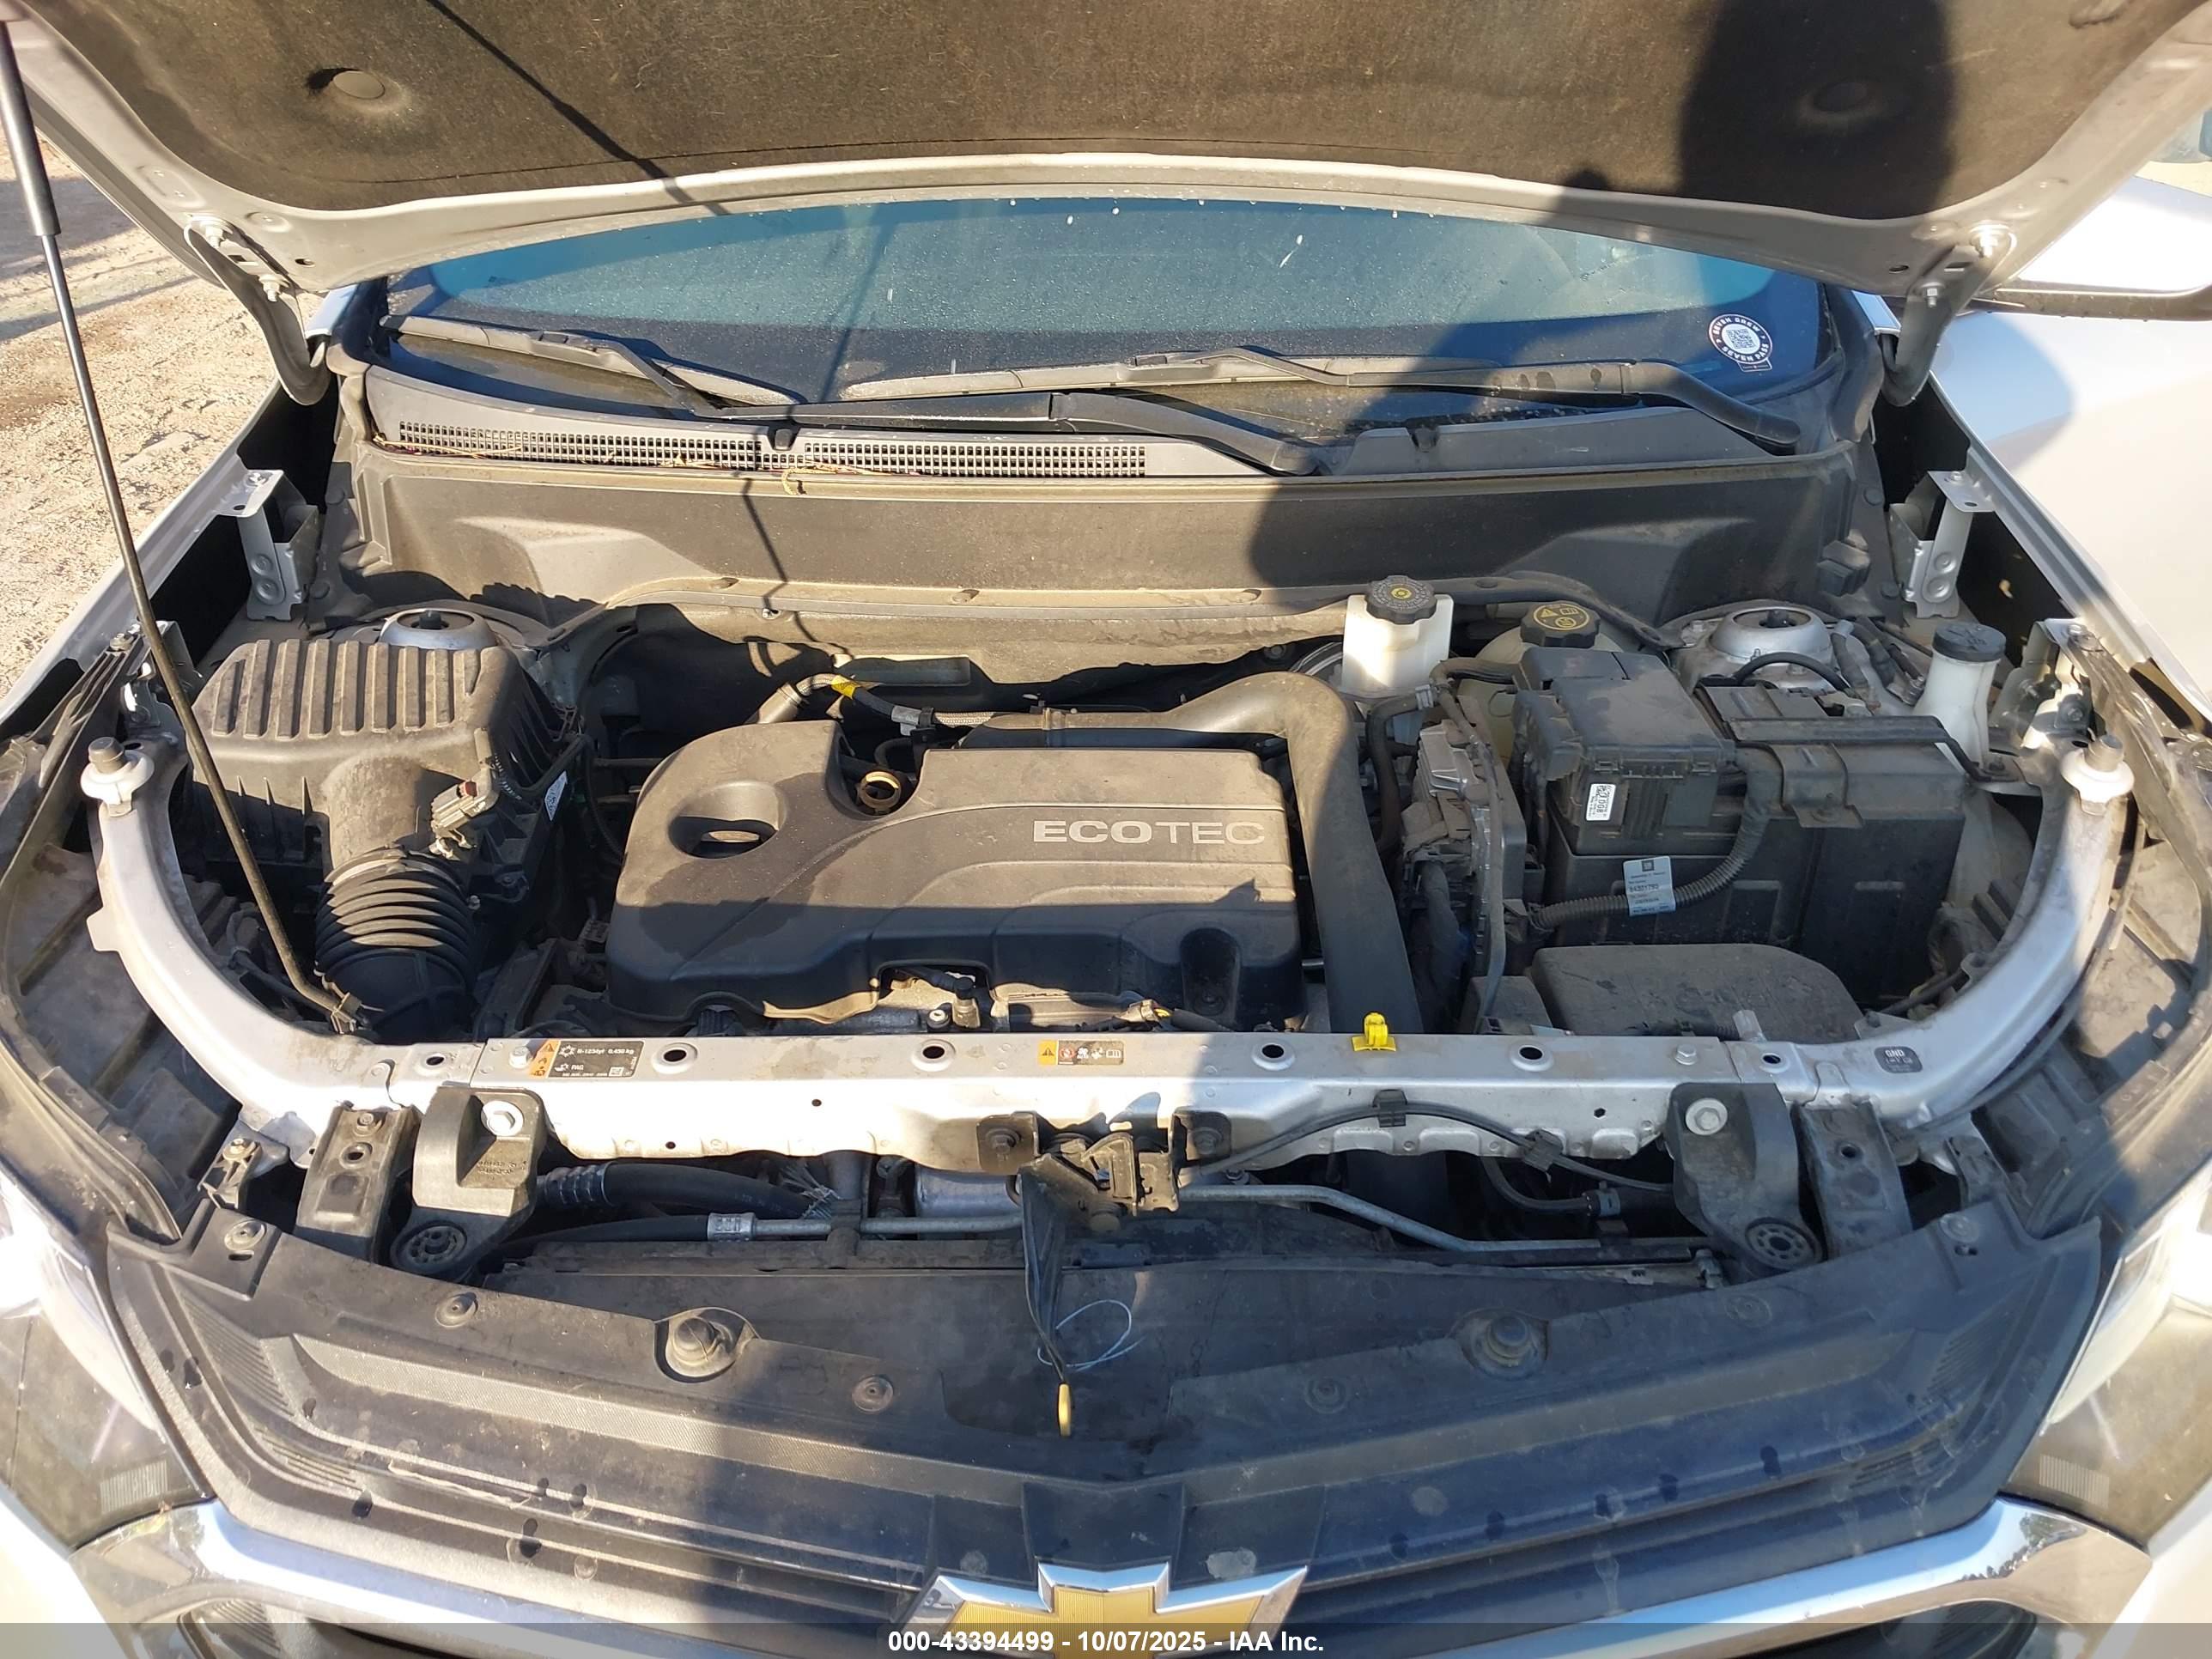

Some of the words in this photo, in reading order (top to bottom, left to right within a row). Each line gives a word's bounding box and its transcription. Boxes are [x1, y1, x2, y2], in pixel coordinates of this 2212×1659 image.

[1722, 346, 1754, 362] SEVEN
[1754, 343, 1769, 359] PASS
[1033, 820, 1265, 844] ECOTEC
